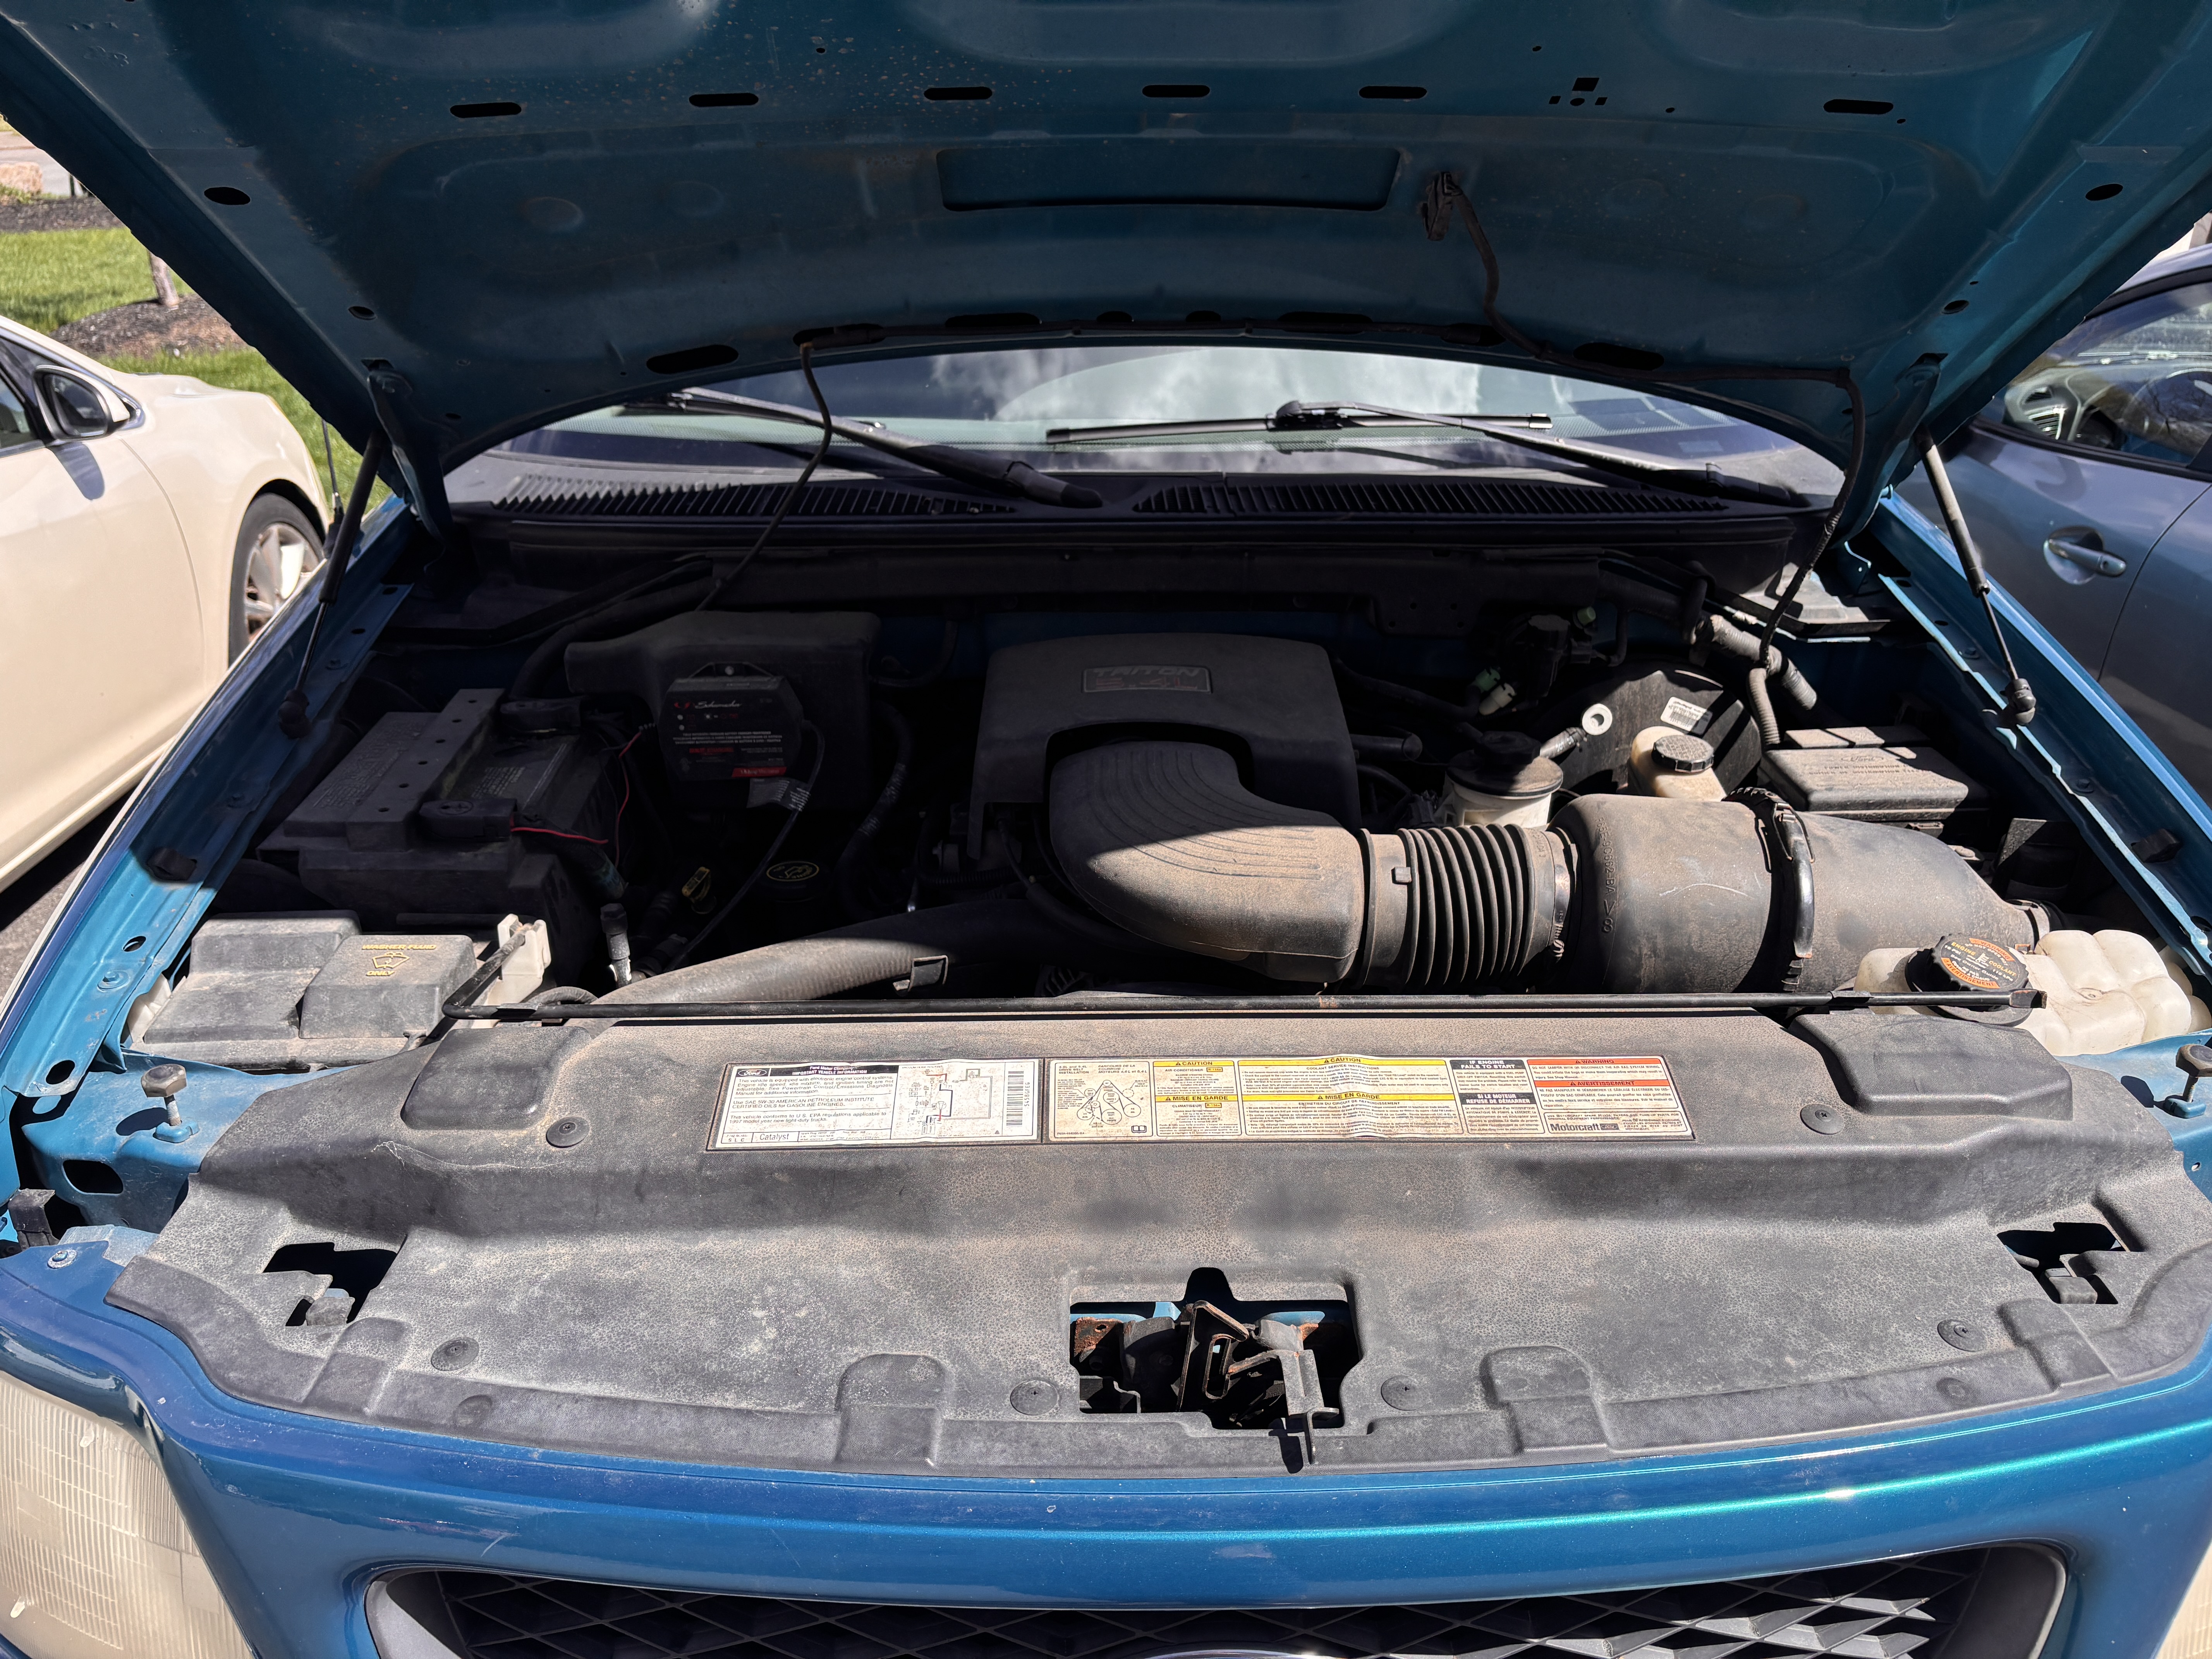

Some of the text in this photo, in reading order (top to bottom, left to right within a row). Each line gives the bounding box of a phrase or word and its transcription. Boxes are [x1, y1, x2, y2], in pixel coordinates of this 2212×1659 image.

[1092, 668, 1200, 677] TRITON
[1096, 676, 1197, 689] 5.4L
[1951, 942, 1976, 955] ENGINE
[1981, 941, 2010, 959] WARNING
[1946, 961, 1994, 986] AVERTISSEMENT
[1963, 960, 1981, 970] Owner
[1982, 970, 1998, 980] Guide
[1989, 960, 2016, 976] COOLANT
